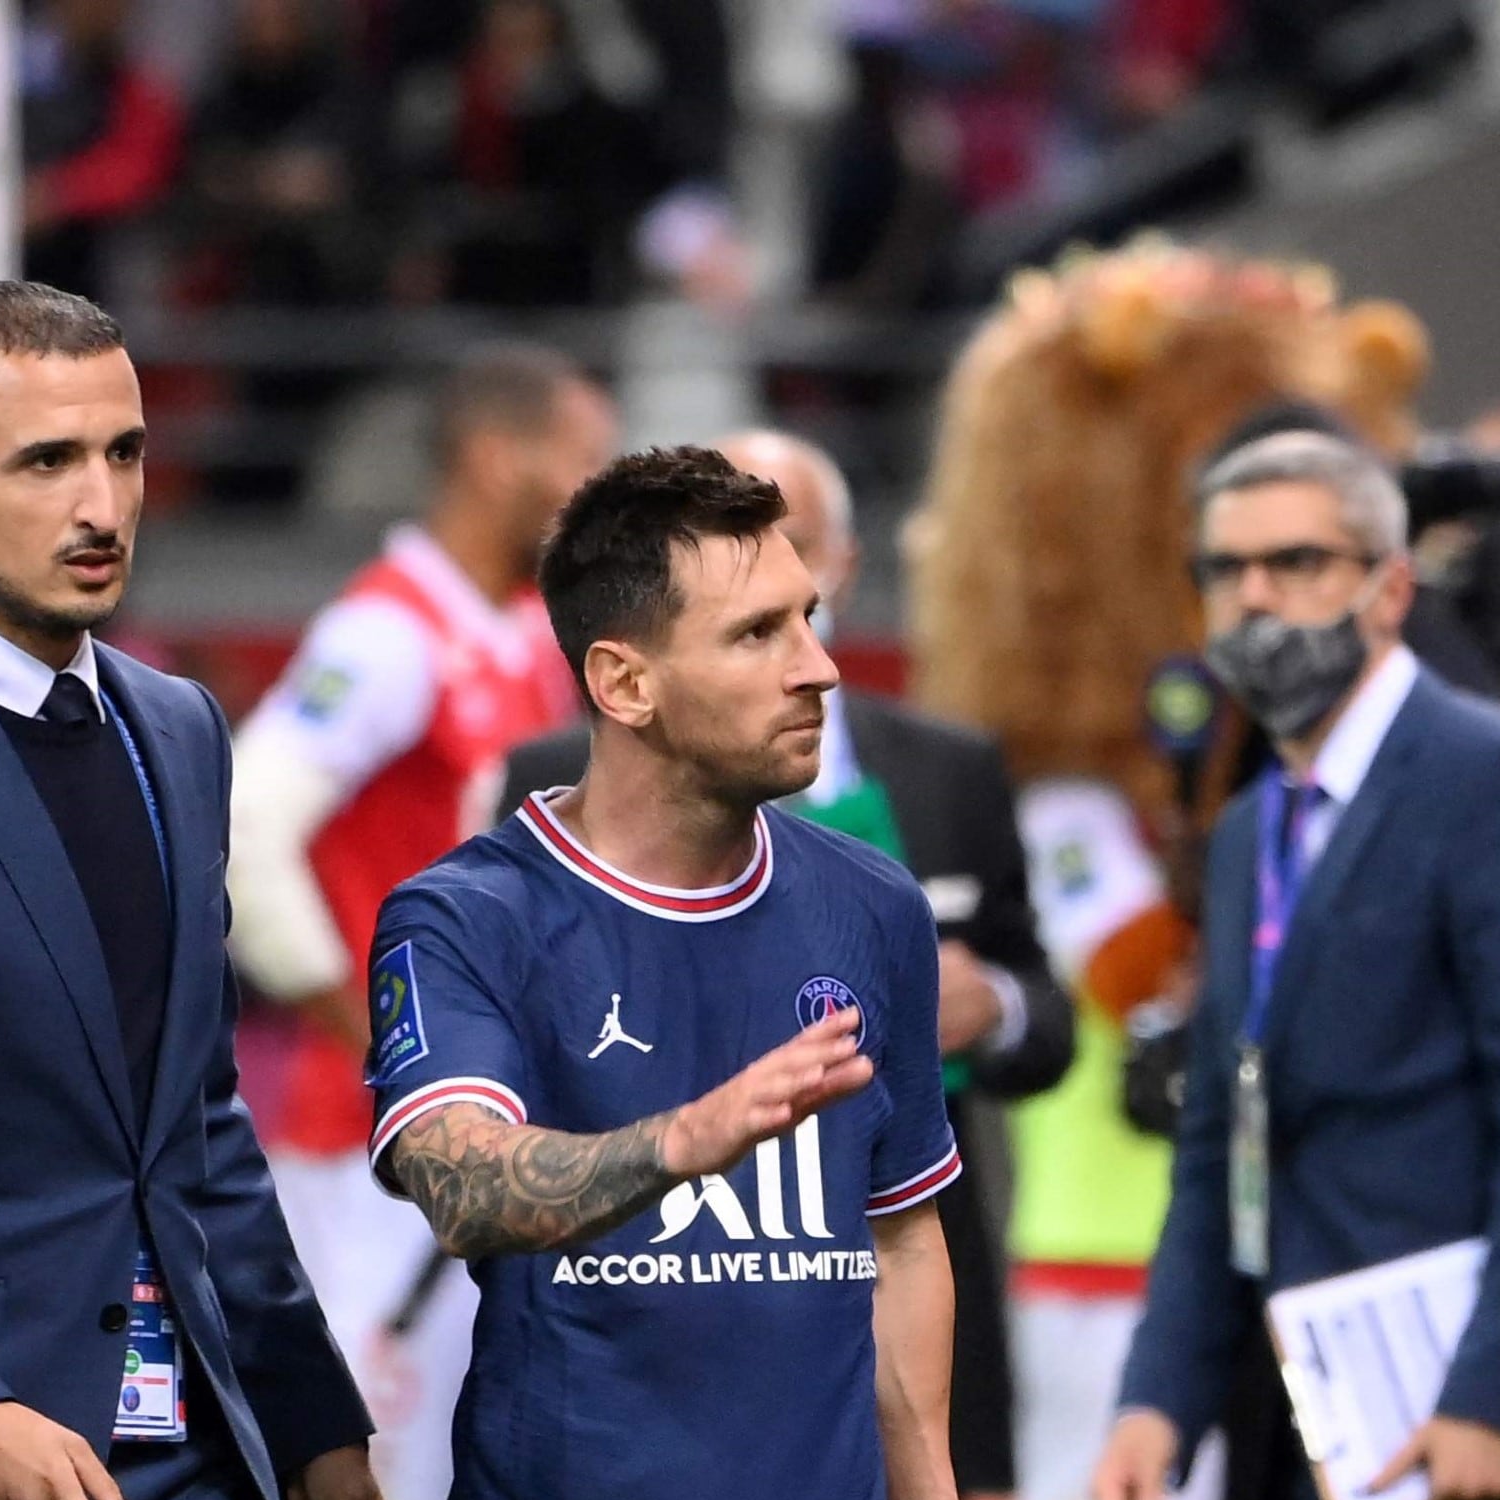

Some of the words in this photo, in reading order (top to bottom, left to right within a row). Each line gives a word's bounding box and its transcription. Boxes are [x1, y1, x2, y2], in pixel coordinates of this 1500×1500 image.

[803, 981, 849, 1001] PARIS
[552, 1254, 684, 1285] ACCOR
[690, 1252, 763, 1283] LIVE
